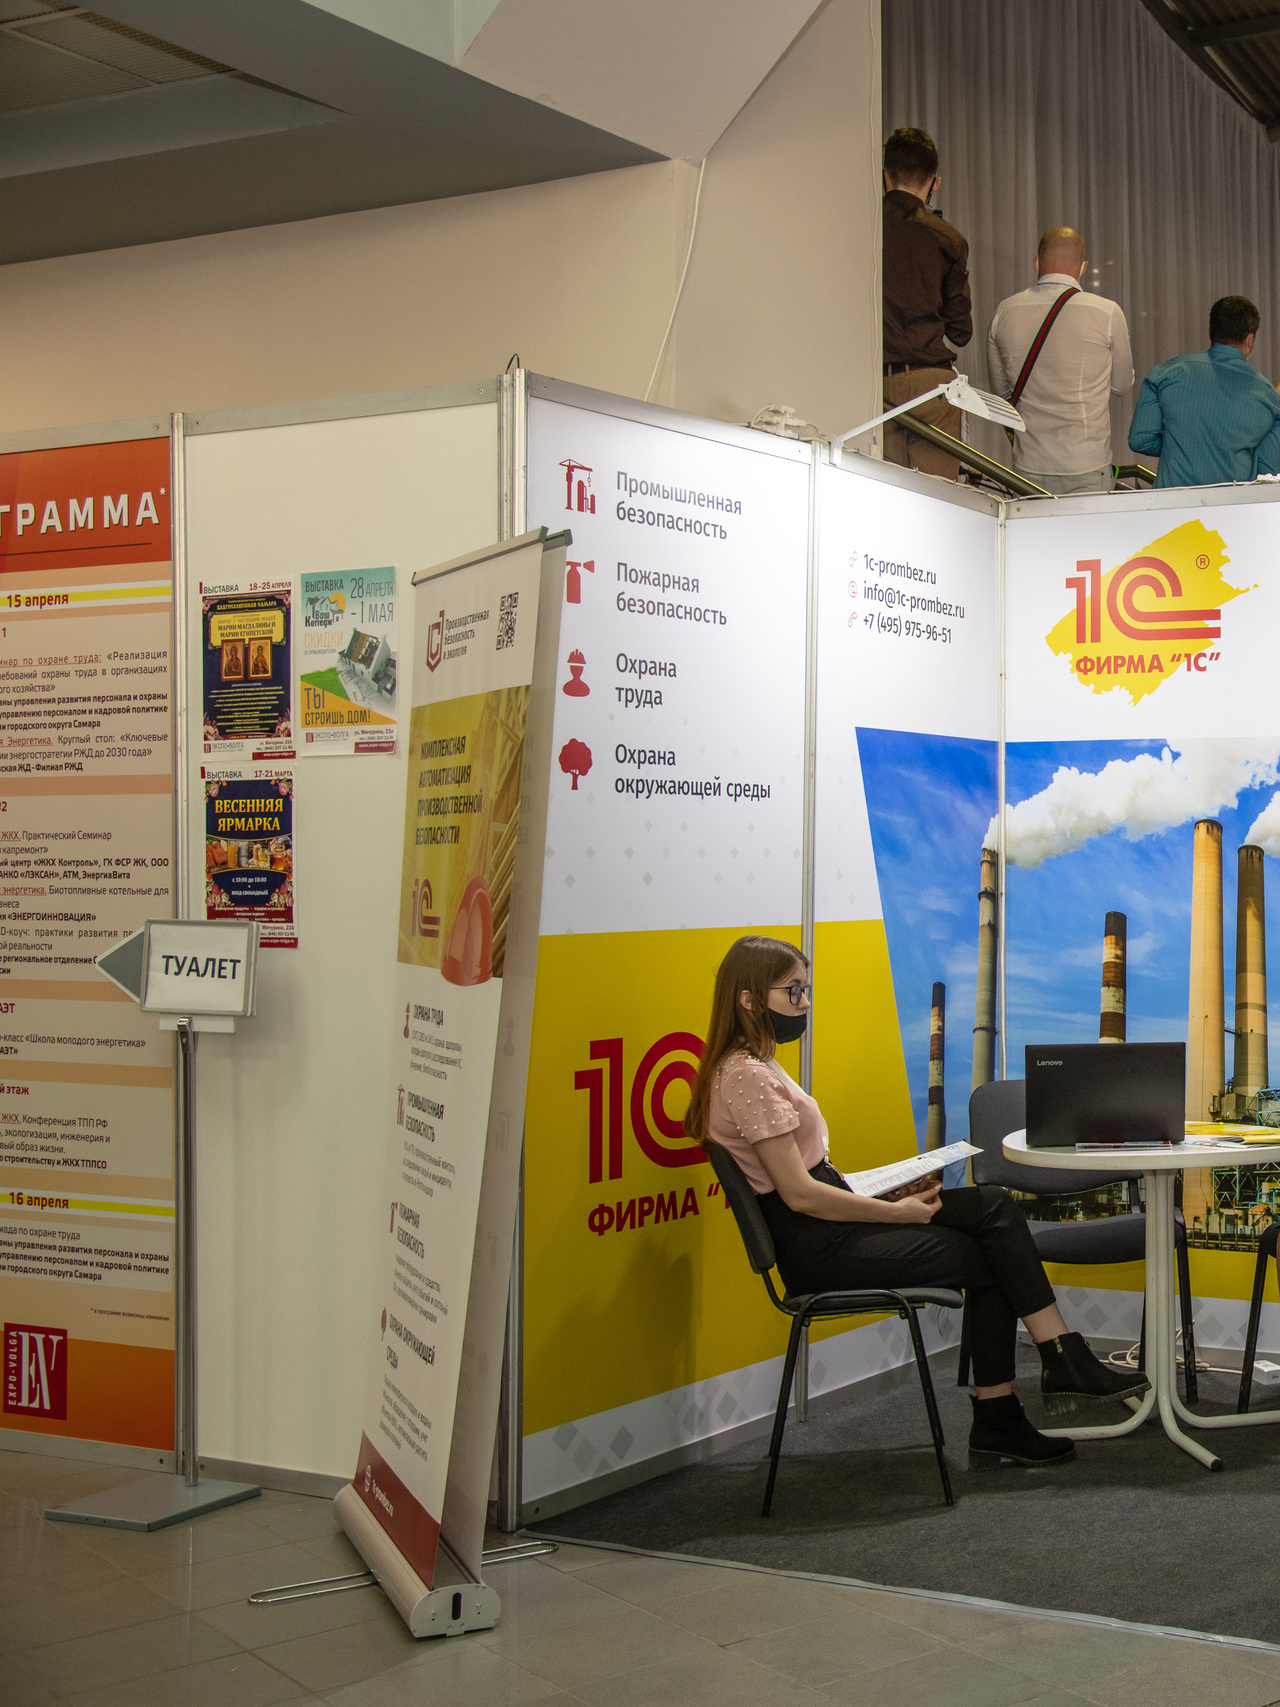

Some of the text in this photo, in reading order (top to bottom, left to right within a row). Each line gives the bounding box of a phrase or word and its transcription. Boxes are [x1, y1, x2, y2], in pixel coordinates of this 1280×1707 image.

[617, 470, 742, 516] Промышленная
[616, 500, 727, 540] безопасность
[616, 560, 700, 594] Пожарная
[863, 553, 937, 585] 1c-prombez.ru
[204, 584, 239, 594] ВЫСТАВКА
[271, 581, 292, 589] АПРЕЛЯ
[306, 579, 344, 592] ВЫСТАВКА
[350, 577, 394, 599] 28 АПРЕЛЯ
[7, 593, 70, 609] 15 апреля
[863, 580, 965, 619] info@1c-prombez.ru
[368, 602, 394, 623] МАЯ
[616, 591, 727, 626] безопасность
[863, 612, 951, 645] +7 (495) 975-96-51
[304, 631, 343, 649] СКИДКИ
[38, 650, 168, 667] охране труда: «Реализация
[615, 652, 678, 680] Охрана
[1075, 653, 1165, 676] ФИРМА
[42, 665, 168, 681] охраны труда организациях
[12, 684, 56, 694] хозяйства»
[615, 683, 664, 709] труда
[14, 692, 168, 707] управления развития персонала охраны
[304, 687, 326, 710] ТЫ
[43, 704, 168, 718] персоналом кадровой политике
[305, 709, 371, 726] СТРОИШЬ ДОМ!
[7, 719, 101, 732] городского округа Самара
[8, 732, 168, 747] Энергетика. Круглый стол: «Ключевые
[10, 747, 152, 762] энергостратегии РЖД 2030 года»
[614, 743, 677, 769] Охрана
[18, 761, 84, 774] ЖД Филиал РЖД
[206, 770, 242, 780] ВЫСТАВКА
[614, 776, 772, 802] окружающей среды
[215, 798, 284, 814] ВЕСЕННЯЯ
[218, 816, 281, 832] ЯРМАРКА
[23, 831, 77, 842] Практический
[78, 831, 112, 842] Семинар
[2, 846, 49, 857] капремонт»
[11, 860, 32, 869] центр
[34, 858, 56, 867] «ЖКХ
[59, 858, 101, 869] Контроль»,
[115, 857, 131, 867] ФСР
[151, 858, 169, 867] ООО
[20, 870, 131, 881] «ЛЭКСАН», АТМ, ЭнергиаВита
[3, 885, 169, 897] энергетика. Биотопливные котельные для
[8, 912, 97, 924] «ЭНЕРГОИННОВАЦИЯ»
[35, 929, 74, 940] практики
[79, 929, 119, 940] развития
[9, 943, 53, 955] реальности
[3, 955, 93, 966] региональное отделение
[161, 954, 242, 981] ТУАЛЕТ
[25, 1033, 147, 1050] «Школа молодого энергетика»
[1037, 1059, 1063, 1067] Lenovo
[6, 1086, 30, 1097] этаж
[23, 1114, 77, 1127] Конференция
[78, 1117, 95, 1128] ТПП
[96, 1119, 108, 1129] РФ
[4, 1128, 104, 1145] экологизация, инженерия
[16, 1143, 66, 1155] образ жизни.
[4, 1156, 107, 1171] строительству ЖКХ ТППСО
[9, 1191, 69, 1210] 16 апреля
[588, 1186, 700, 1237] ФИРМА
[29, 1229, 81, 1243] охране труда
[8, 1330, 18, 1406] EXPO-VOLGA
